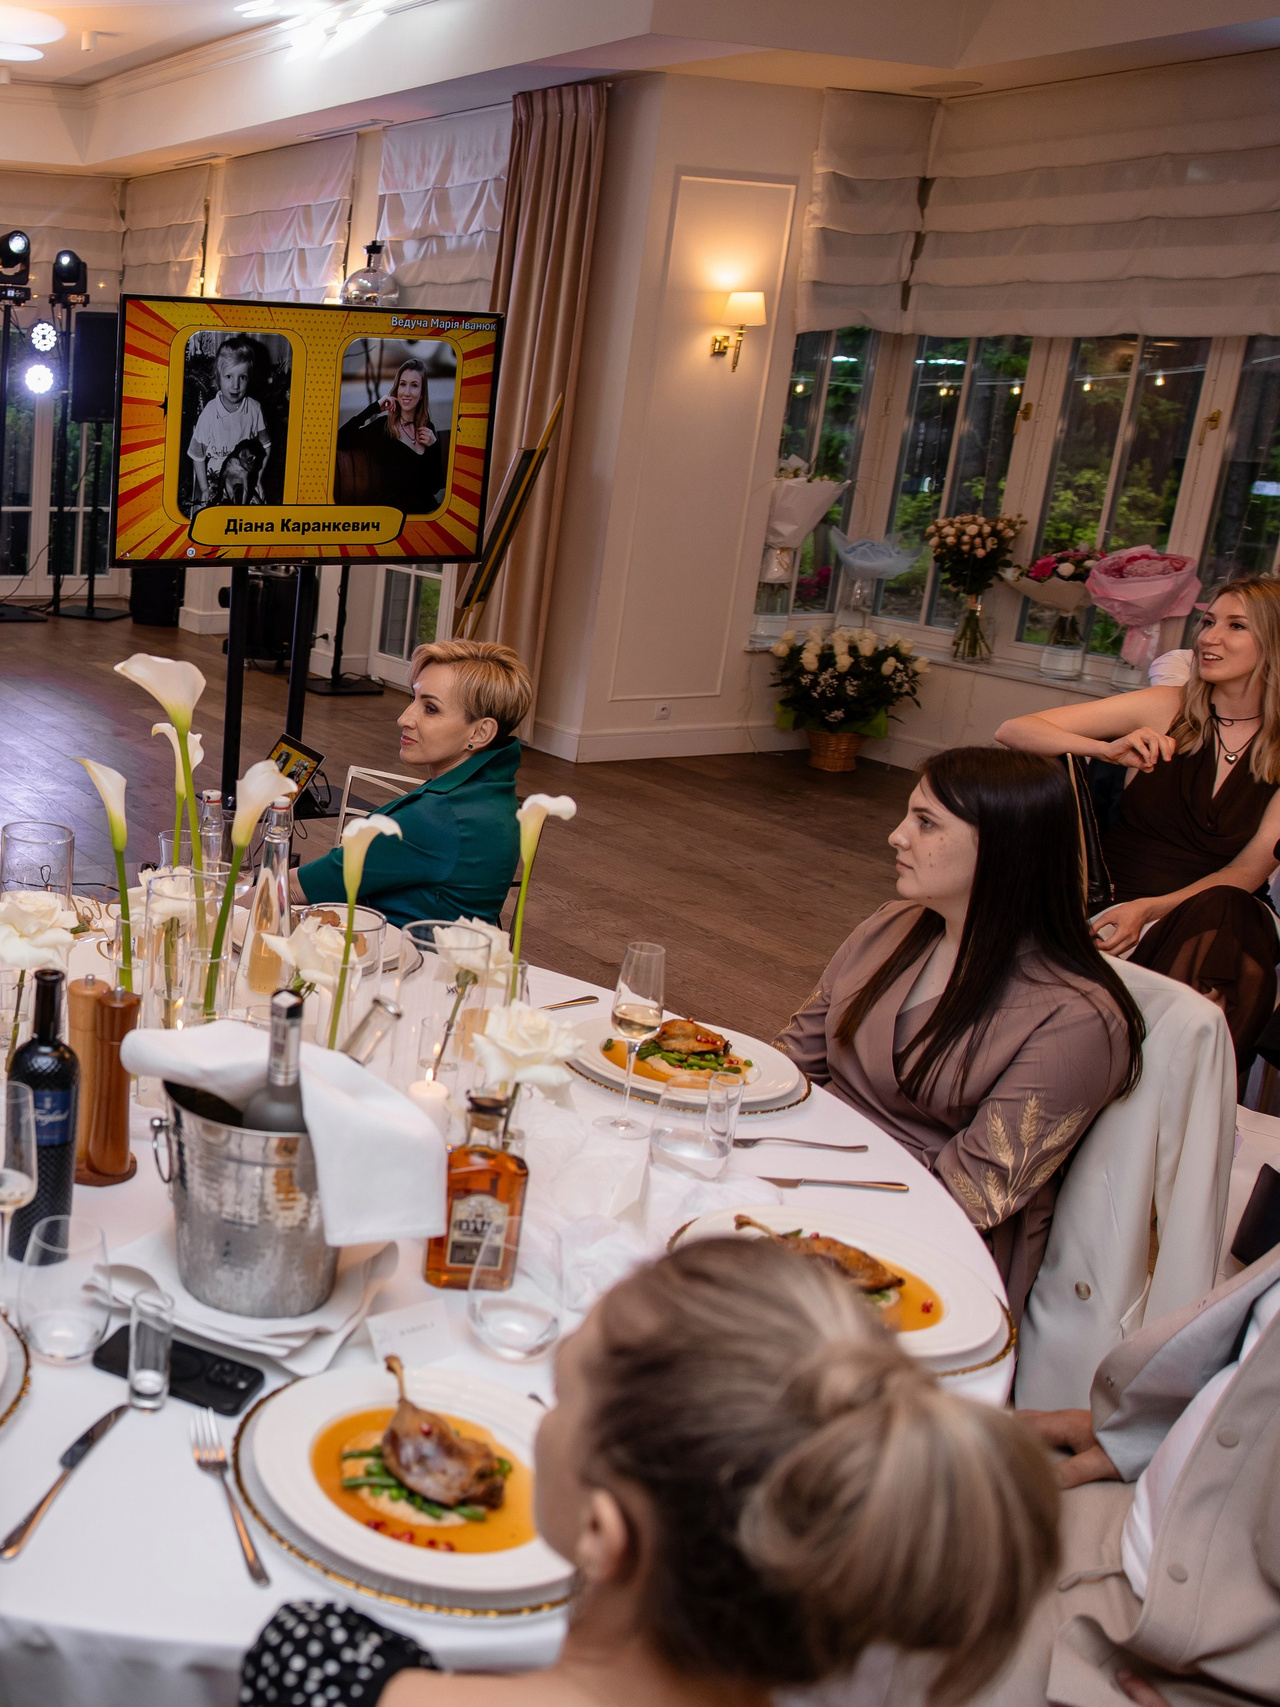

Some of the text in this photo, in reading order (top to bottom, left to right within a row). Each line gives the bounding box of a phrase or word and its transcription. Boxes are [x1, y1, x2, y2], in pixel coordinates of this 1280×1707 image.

[391, 316, 428, 329] Ведуча
[430, 318, 459, 331] Марія
[224, 518, 381, 535] Діана Каранкевич
